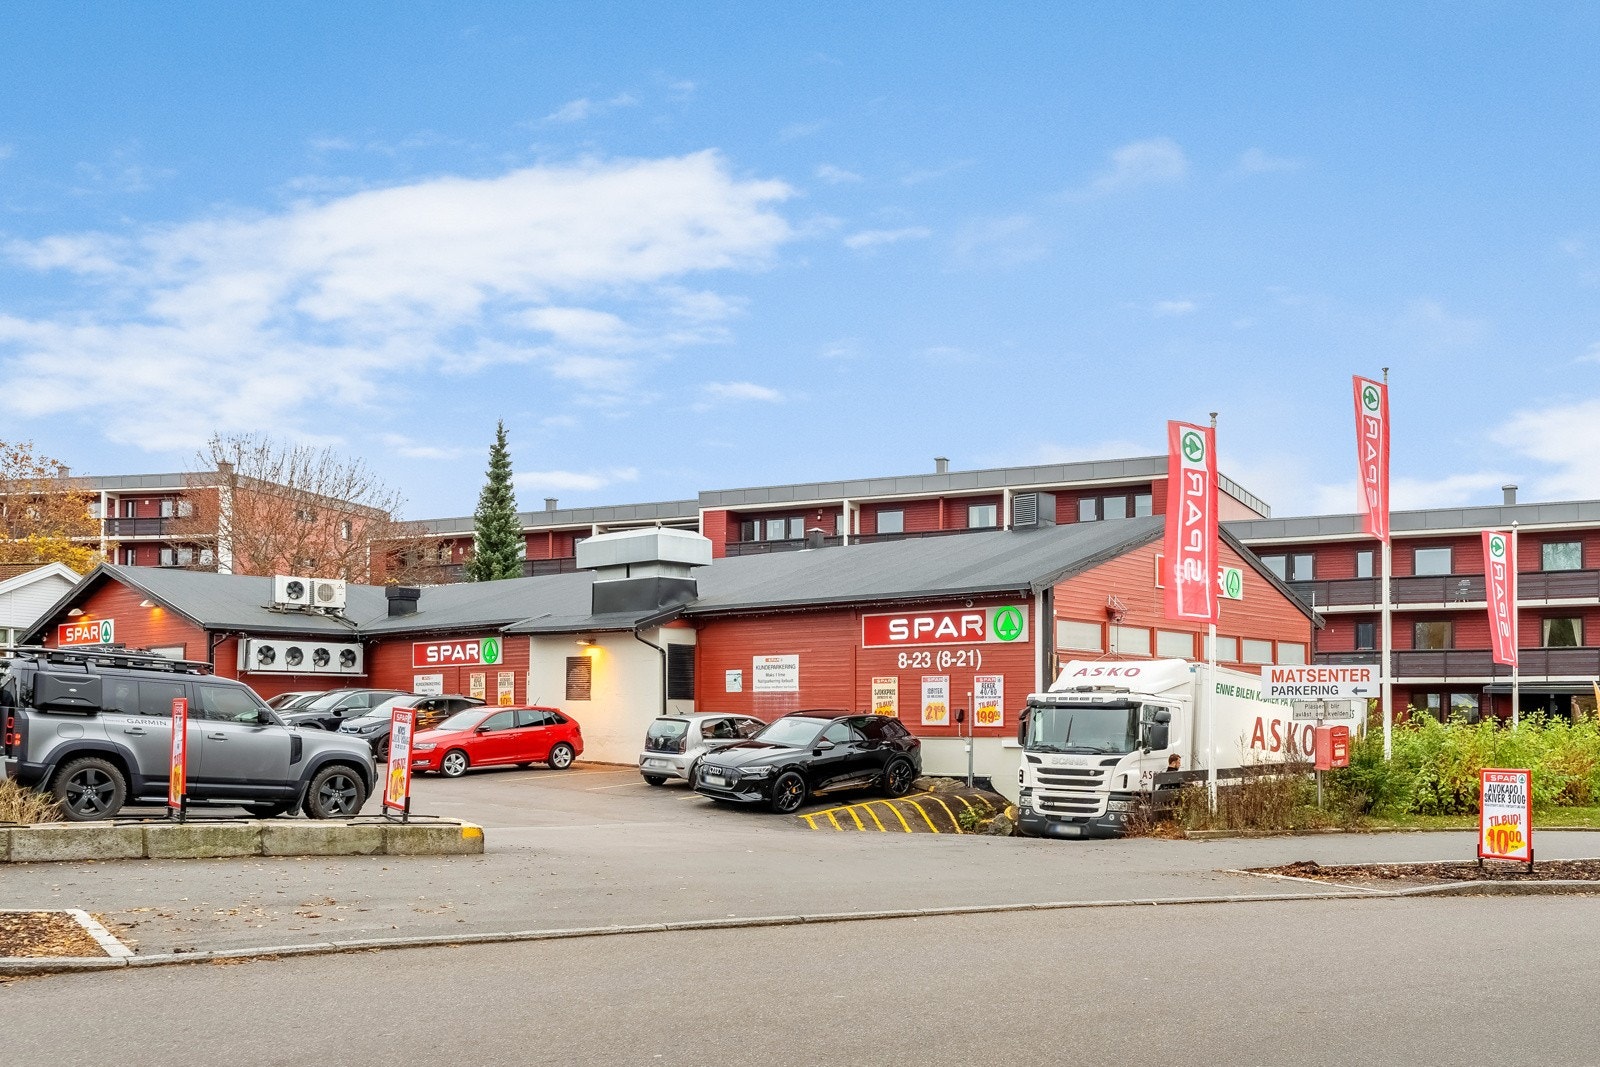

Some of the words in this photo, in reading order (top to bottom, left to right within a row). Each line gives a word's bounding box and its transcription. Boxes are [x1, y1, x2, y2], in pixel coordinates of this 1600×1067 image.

[66, 625, 99, 642] SPAR
[888, 615, 984, 640] SPAR
[426, 643, 479, 662] SPAR
[897, 651, 931, 669] 8-23
[936, 649, 982, 671] (8-21)
[1073, 667, 1141, 677] ASKO
[1271, 668, 1370, 683] MATSENTER
[1236, 687, 1255, 701] BILEN
[1271, 685, 1339, 696] PARKERING
[126, 718, 167, 726] GARMIN
[1250, 716, 1316, 757] ASKO
[1490, 774, 1517, 782] SPAR
[1487, 784, 1519, 795] AVOKADO
[1484, 793, 1506, 804] SKIVER
[1507, 794, 1526, 804] 300G
[1489, 814, 1522, 827] TILBUD!
